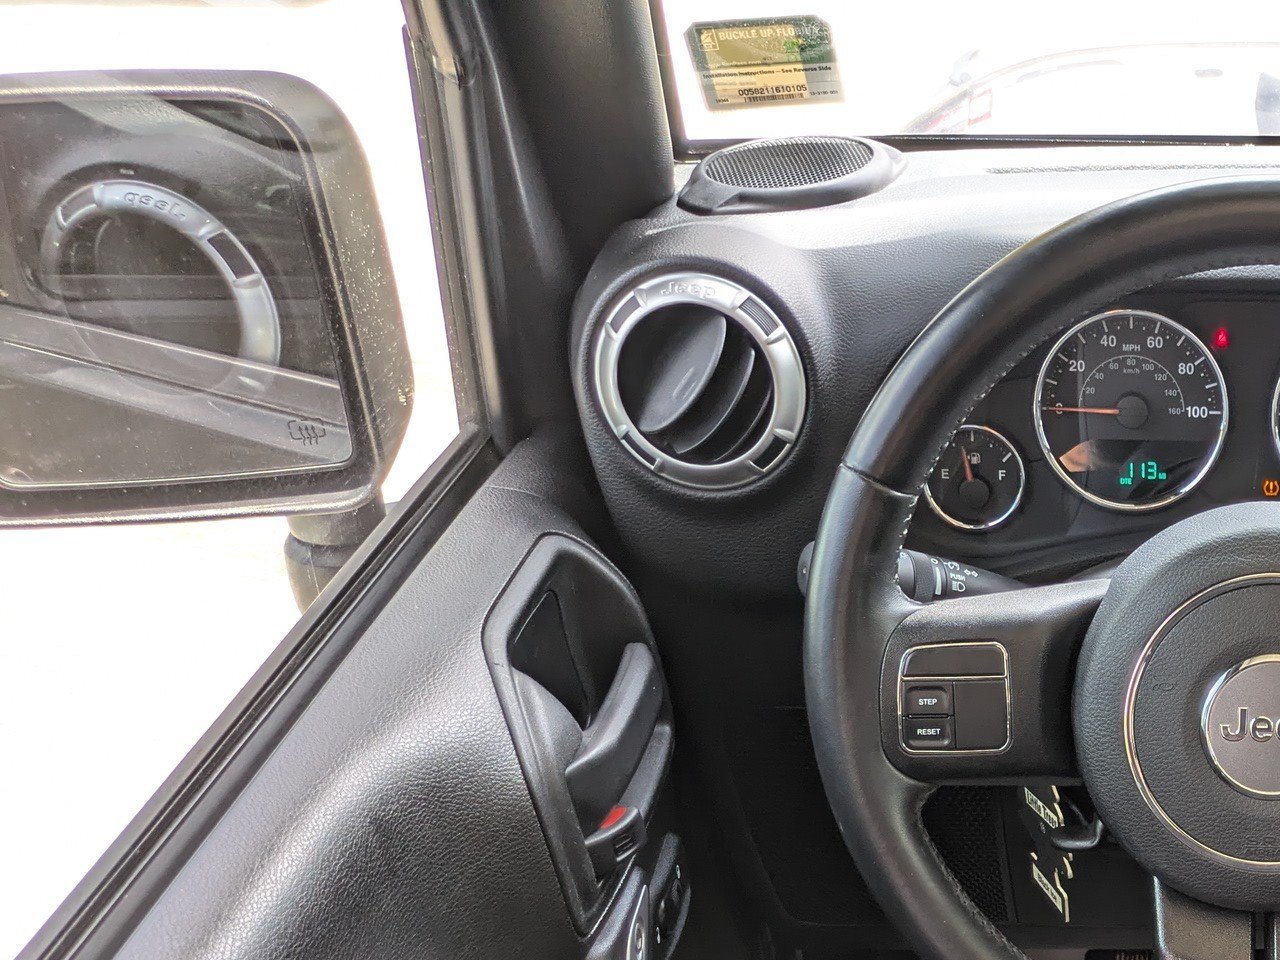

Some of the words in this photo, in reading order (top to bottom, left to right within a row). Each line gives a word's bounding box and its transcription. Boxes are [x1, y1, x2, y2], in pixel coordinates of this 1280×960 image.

[720, 30, 757, 41] BUCKLE
[703, 71, 738, 79] Installation
[738, 69, 775, 77] Instructions
[660, 281, 716, 299] Jeep
[1100, 335, 1117, 348] 40
[1147, 336, 1164, 349] 60
[1122, 344, 1141, 352] MPH
[1069, 360, 1085, 373] 20
[1142, 363, 1155, 371] 100
[1178, 363, 1195, 375] 80
[1094, 372, 1104, 380] 40
[1164, 389, 1178, 397] 140
[1168, 407, 1181, 415] 160
[1186, 406, 1208, 419] 100
[941, 469, 950, 479] E
[999, 470, 1006, 481] F
[1130, 461, 1157, 480] 113
[950, 573, 966, 581] PUSH
[918, 698, 938, 706] STEP
